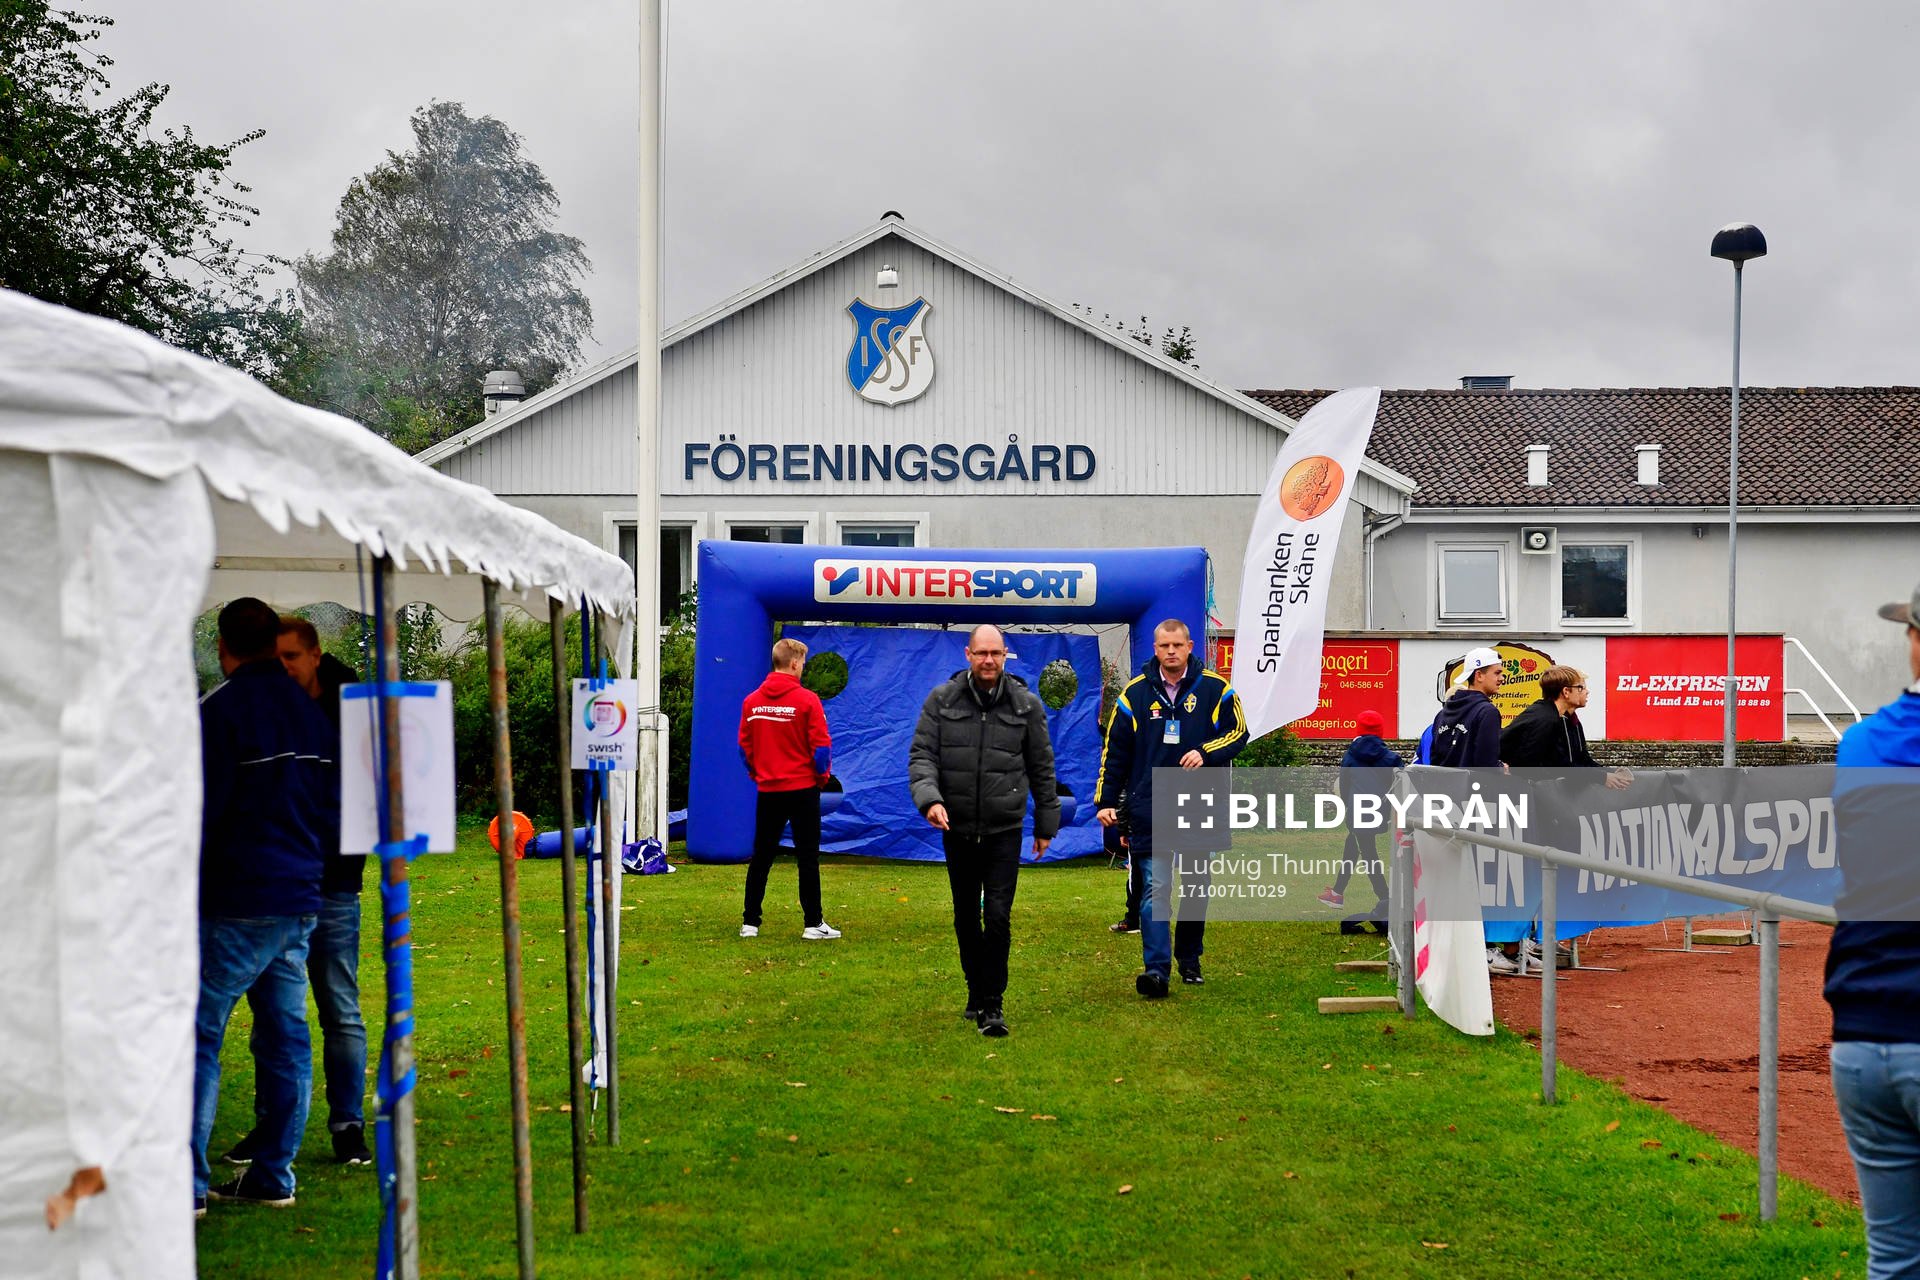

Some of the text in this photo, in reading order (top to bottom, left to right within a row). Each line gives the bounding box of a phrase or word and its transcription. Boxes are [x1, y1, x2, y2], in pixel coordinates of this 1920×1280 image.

[684, 433, 1097, 482] FÖRENINGSGÅRD
[865, 567, 1083, 599] INTERSPORT
[1289, 532, 1320, 604] Skåne
[1256, 532, 1295, 674] Sparbanken
[1373, 681, 1384, 689] 45
[1652, 696, 1682, 706] Lund
[1683, 696, 1700, 706] AB
[587, 742, 623, 753] swish
[1577, 796, 1840, 894] NATIONALSPO
